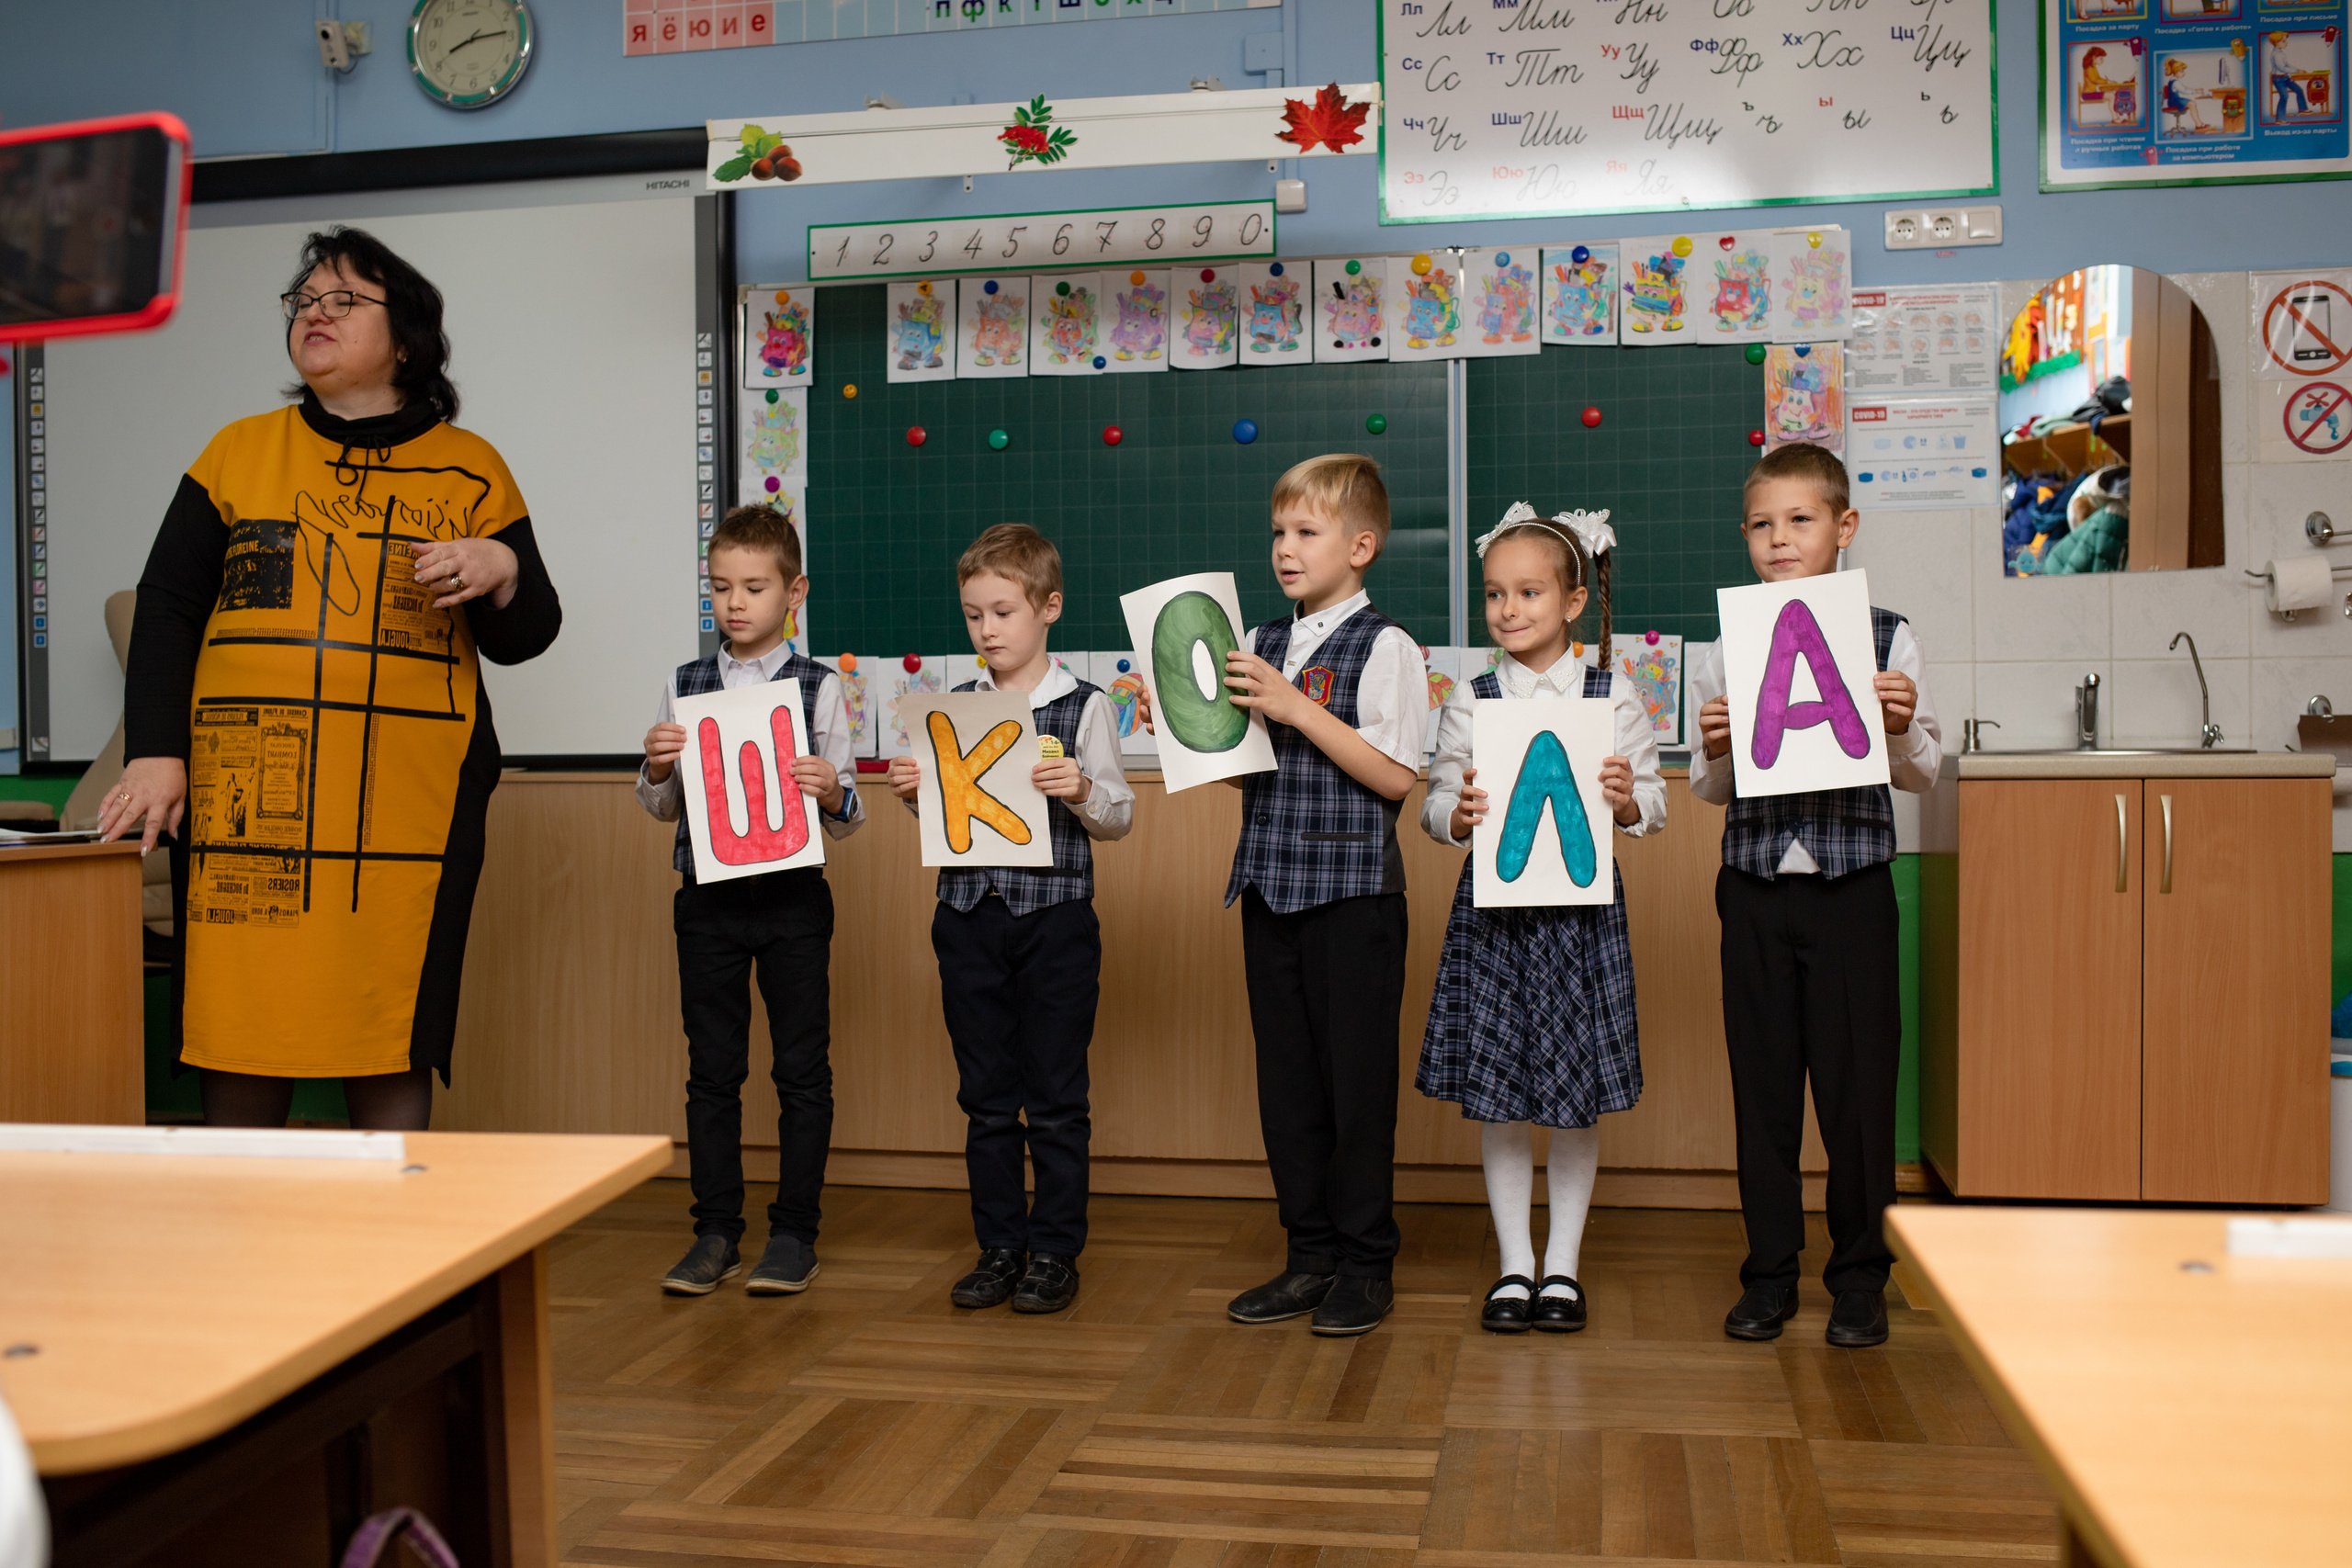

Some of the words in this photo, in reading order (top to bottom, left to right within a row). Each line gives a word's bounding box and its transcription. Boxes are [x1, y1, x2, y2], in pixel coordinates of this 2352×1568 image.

[1487, 52, 1505, 64] Тт
[1690, 39, 1720, 53] Фф
[1891, 26, 1916, 41] Цц
[1403, 118, 1424, 130] Чч
[1491, 112, 1521, 127] Шш
[1612, 106, 1645, 120] Щщ
[646, 179, 690, 190] HITACHI
[836, 236, 850, 267] 1
[873, 233, 895, 265] 2
[919, 231, 939, 263] 3
[963, 228, 983, 260] 4
[1001, 226, 1028, 258] 5
[1052, 223, 1073, 255] 6
[1096, 220, 1118, 253] 7
[1145, 218, 1166, 250] 8
[1193, 215, 1213, 248] 9
[1854, 410, 1886, 420] COVID-19
[697, 705, 809, 866] Ш
[926, 710, 1032, 854] К
[1151, 590, 1251, 755] О
[1495, 729, 1597, 889] Л
[1751, 598, 1871, 771] А
